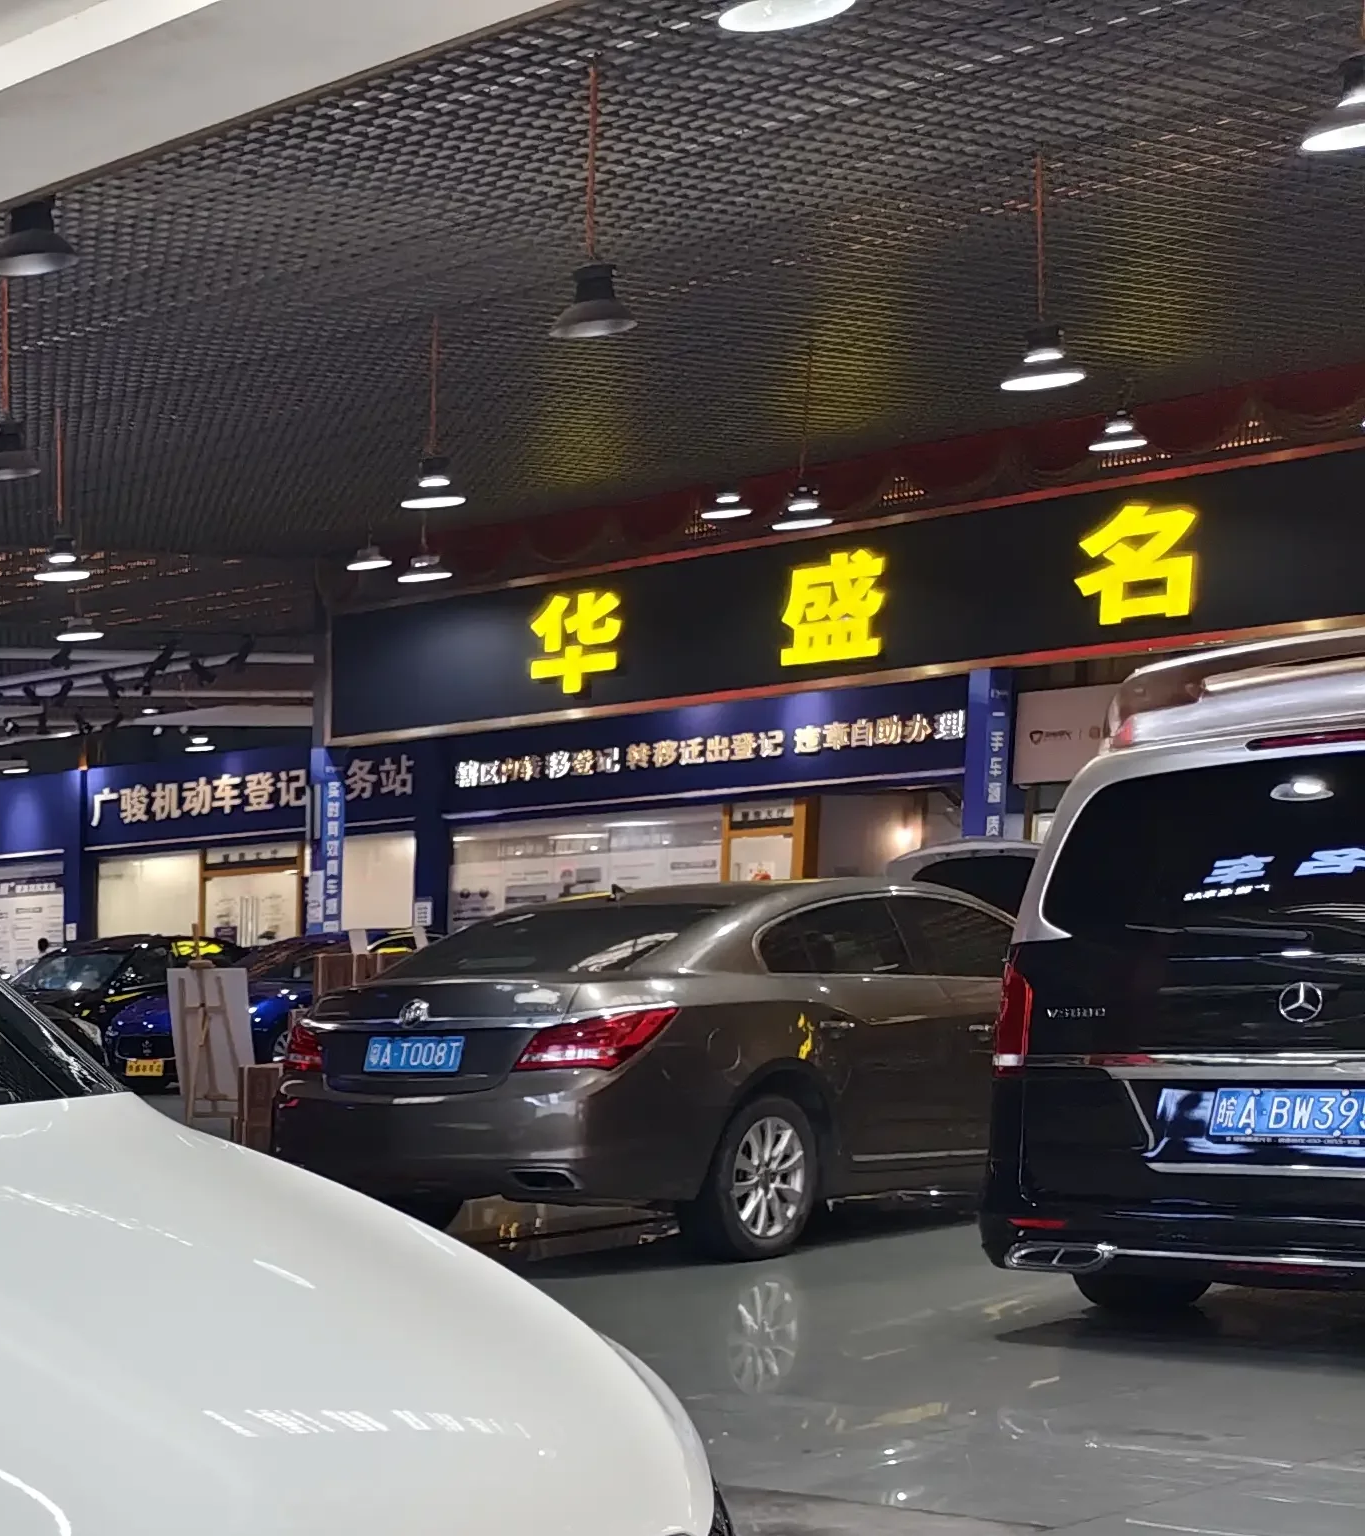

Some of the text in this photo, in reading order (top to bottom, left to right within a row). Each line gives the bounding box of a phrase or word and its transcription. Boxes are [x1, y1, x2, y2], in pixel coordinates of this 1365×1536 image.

[626, 730, 786, 770] 转移迁出登记
[793, 709, 966, 754] 违章自助办理
[1216, 1095, 1365, 1130] 皖A·BW39
